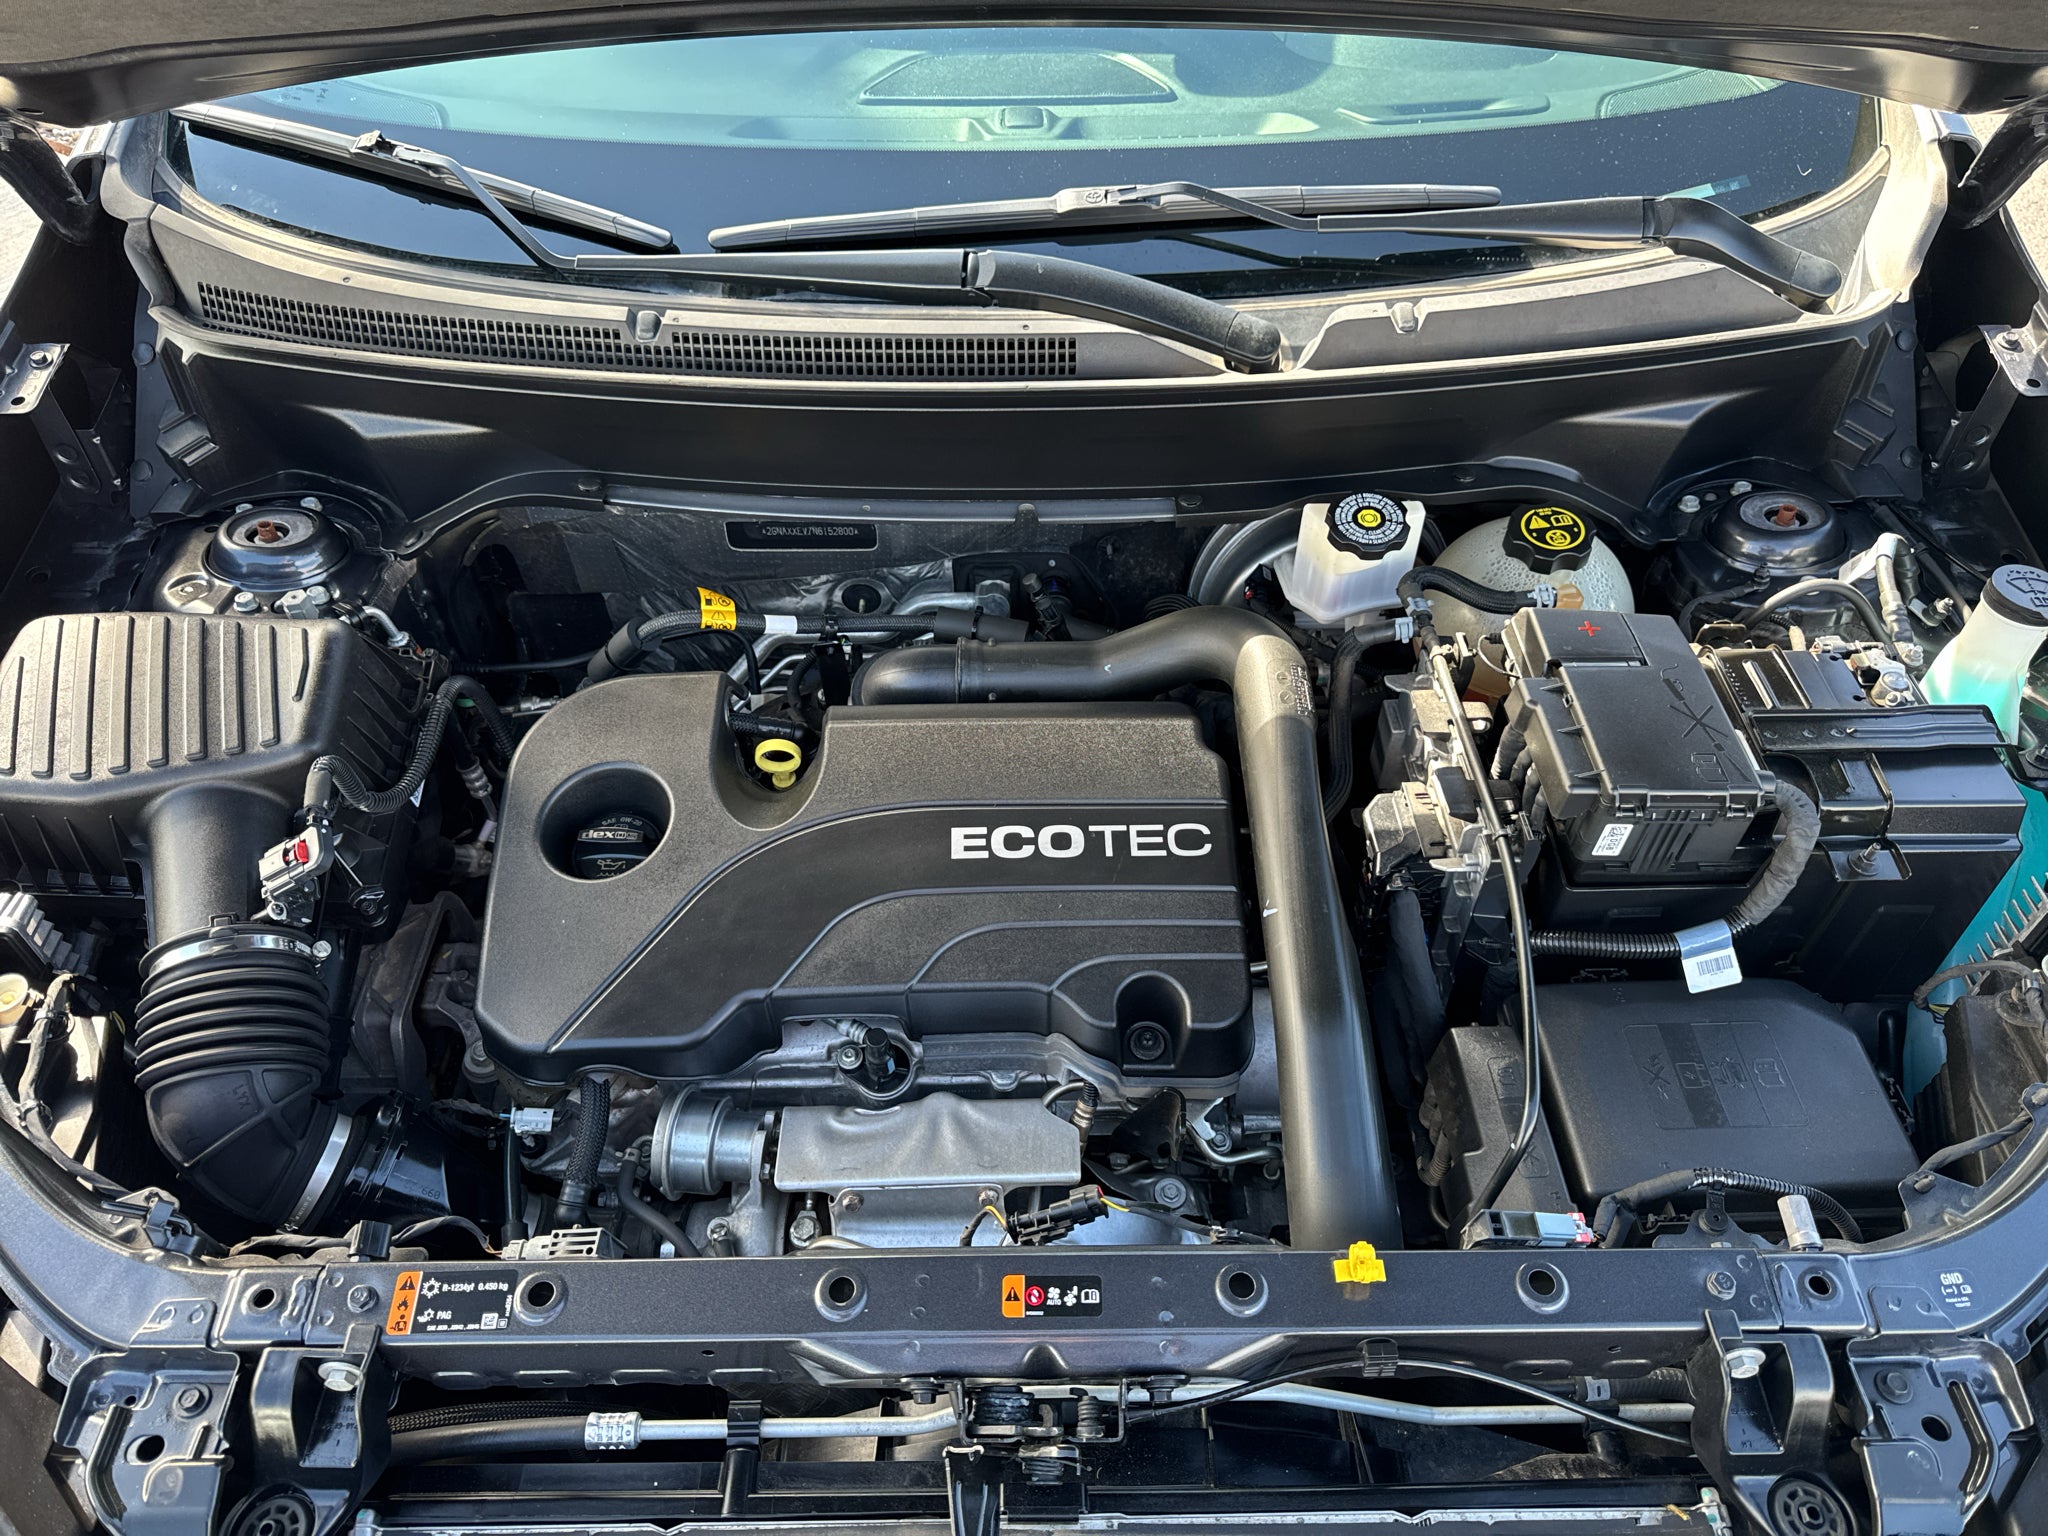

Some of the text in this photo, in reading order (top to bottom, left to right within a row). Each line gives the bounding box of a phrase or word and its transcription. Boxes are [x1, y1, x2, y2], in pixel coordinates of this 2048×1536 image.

[950, 823, 1212, 859] ECOTEC
[1940, 1272, 1963, 1285] GND
[442, 1282, 509, 1293] R-1234yf 0.450 kg
[436, 1310, 452, 1320] PAG
